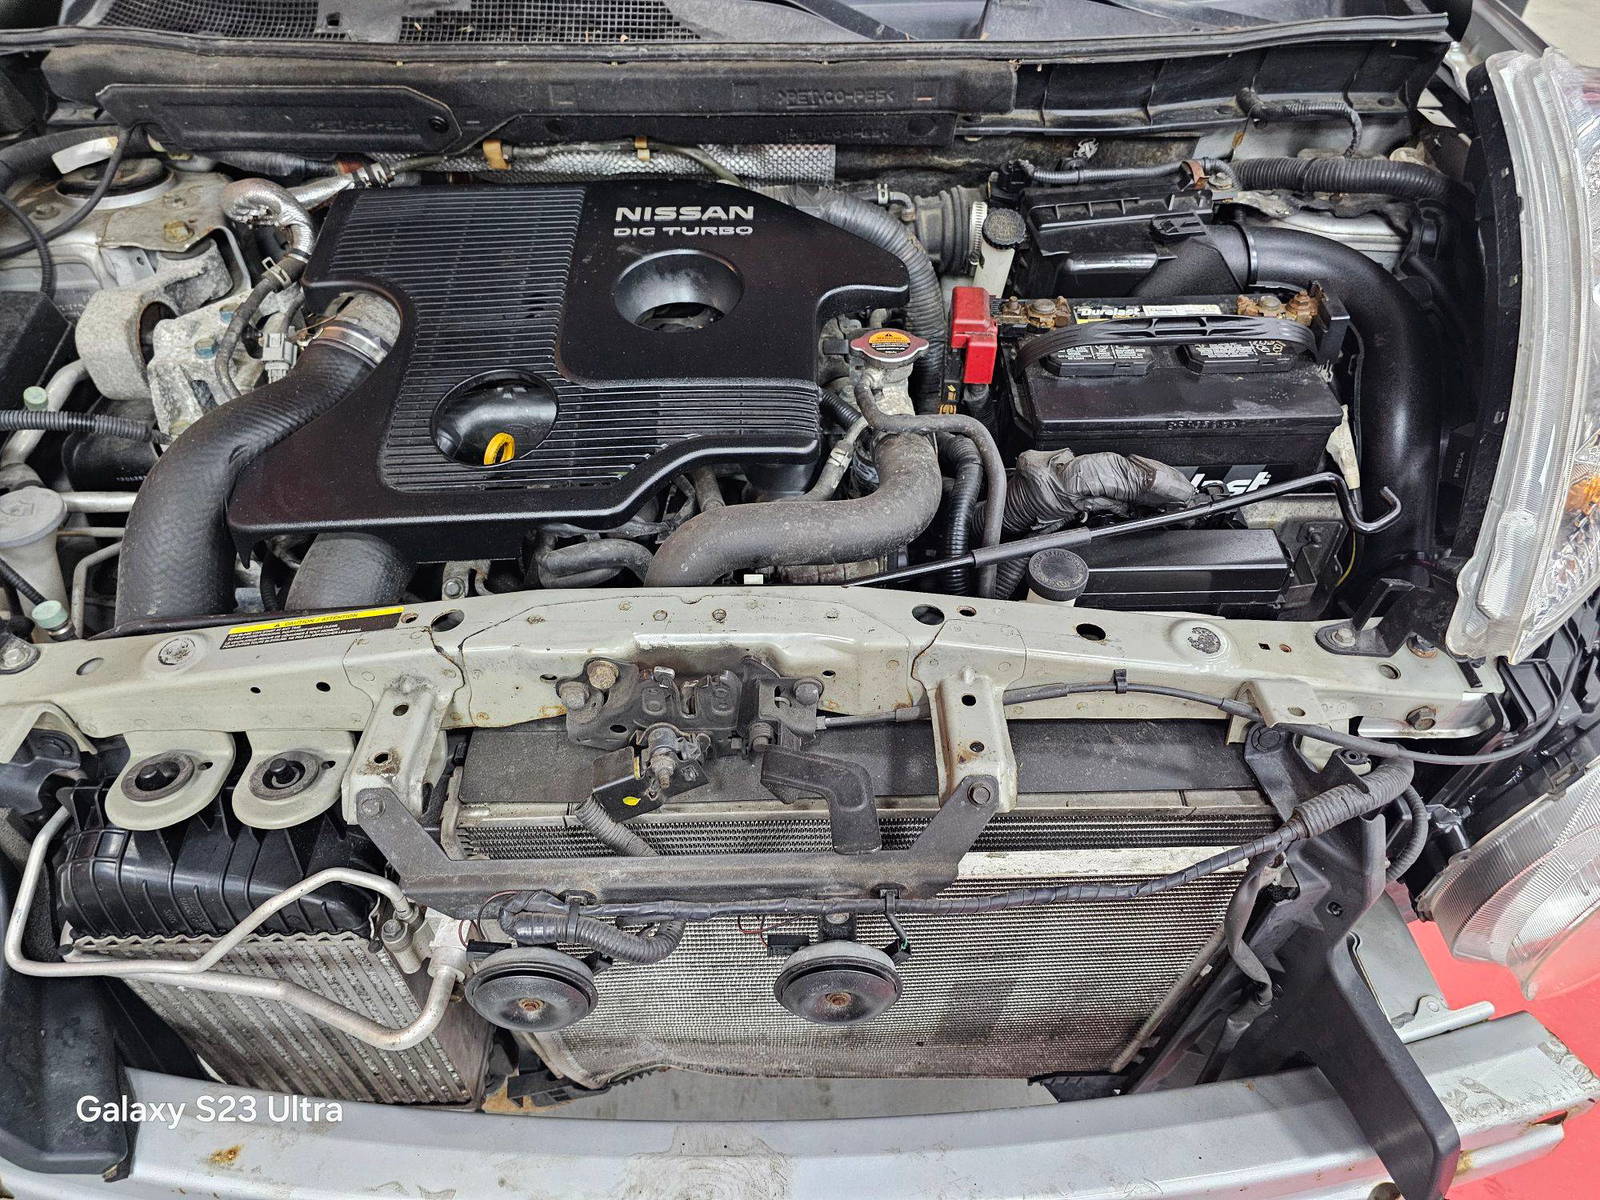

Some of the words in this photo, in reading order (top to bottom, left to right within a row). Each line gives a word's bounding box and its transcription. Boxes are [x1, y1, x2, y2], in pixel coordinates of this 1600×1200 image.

[615, 206, 755, 222] NISSAN
[613, 227, 656, 237] DIG
[662, 226, 754, 236] TURBO
[1080, 307, 1141, 316] Duralast
[284, 618, 315, 626] CAUTION
[321, 613, 359, 622] ATTENTION
